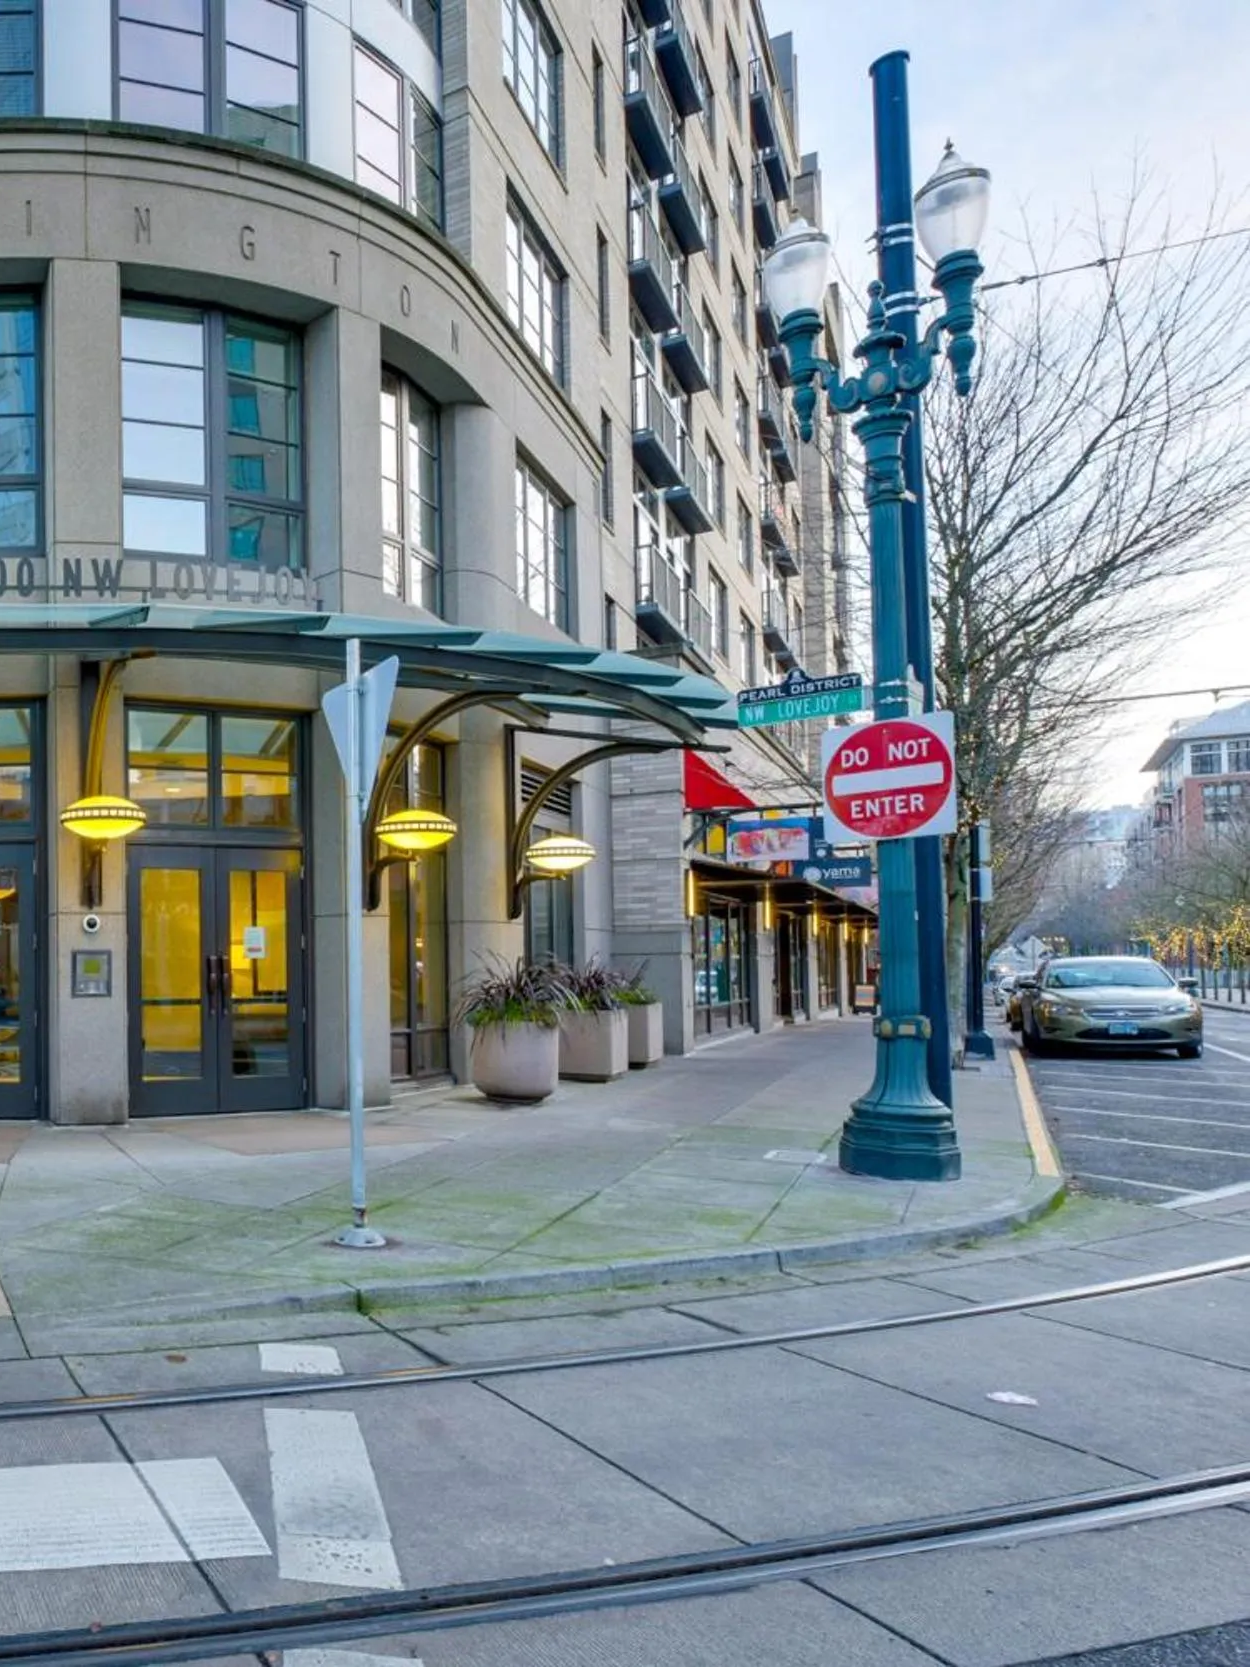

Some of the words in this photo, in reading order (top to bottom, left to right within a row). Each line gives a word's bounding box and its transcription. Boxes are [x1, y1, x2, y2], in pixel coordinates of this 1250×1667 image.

[62, 558, 124, 598] NW
[150, 559, 321, 608] LOVEJOY
[739, 686, 785, 702] PEARL
[790, 674, 859, 695] DISTRICT
[745, 707, 765, 721] NW
[778, 694, 840, 717] LOVEJOY
[840, 747, 869, 768] DO
[888, 737, 931, 761] NOT
[850, 793, 924, 819] ENTER
[822, 866, 861, 879] yama
